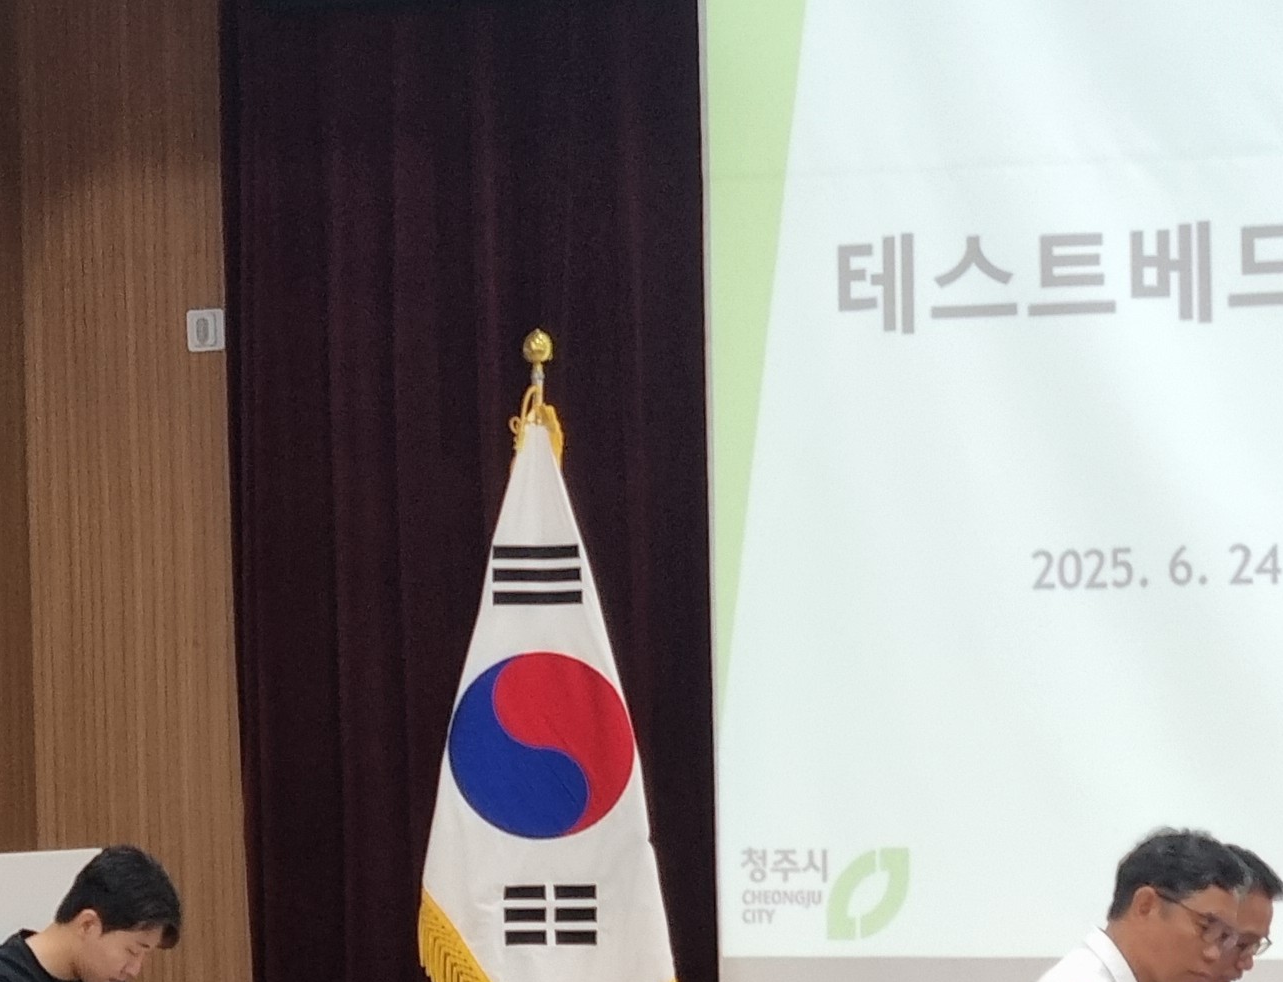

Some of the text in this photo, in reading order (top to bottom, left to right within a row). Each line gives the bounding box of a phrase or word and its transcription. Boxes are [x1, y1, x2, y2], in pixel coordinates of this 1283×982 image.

[1032, 547, 1148, 590] 2025.
[1169, 545, 1208, 587] 6.
[740, 847, 828, 883] 청주시
[742, 889, 822, 908] CHEONGJU
[742, 908, 776, 924] CITY
